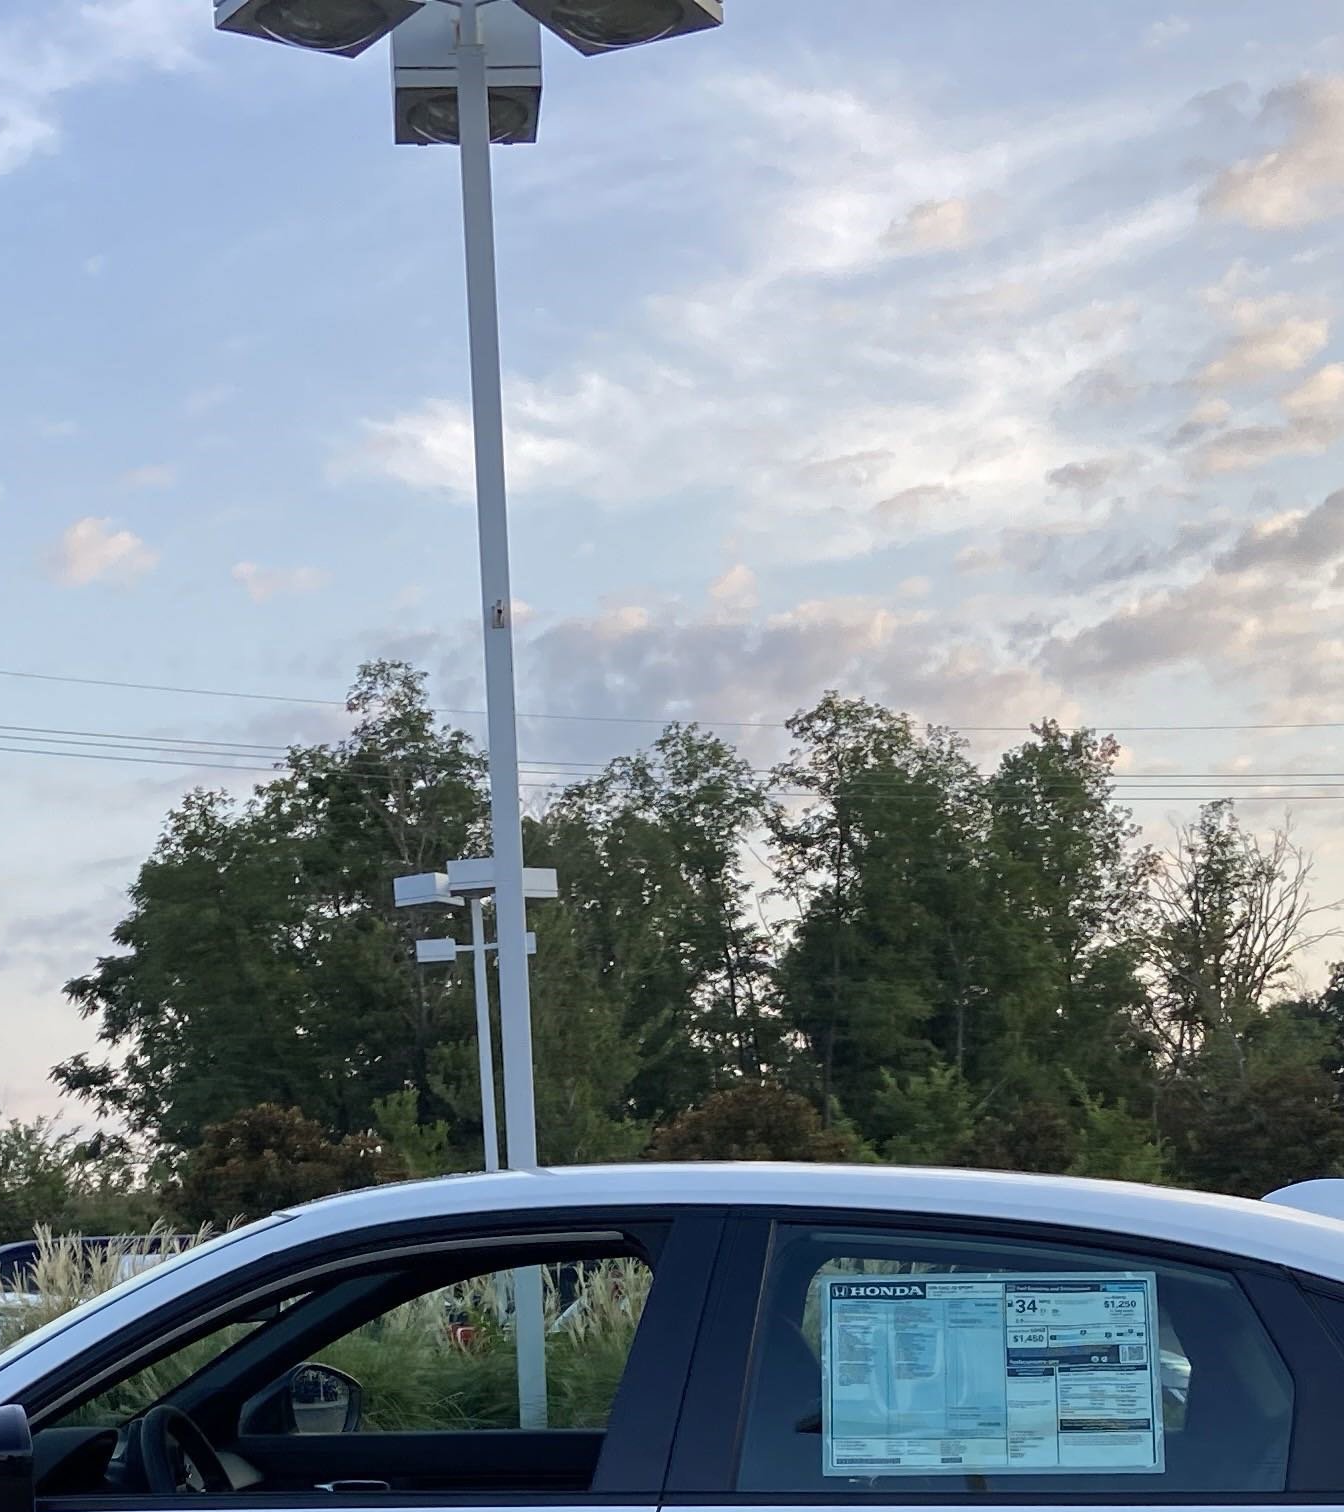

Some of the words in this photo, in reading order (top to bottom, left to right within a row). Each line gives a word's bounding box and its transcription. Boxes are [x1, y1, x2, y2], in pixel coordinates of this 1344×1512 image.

[850, 1286, 924, 1297] HONDA
[1015, 1299, 1038, 1313] 34
[1104, 1300, 1137, 1309] $1,250
[1013, 1334, 1045, 1343] $1,450
